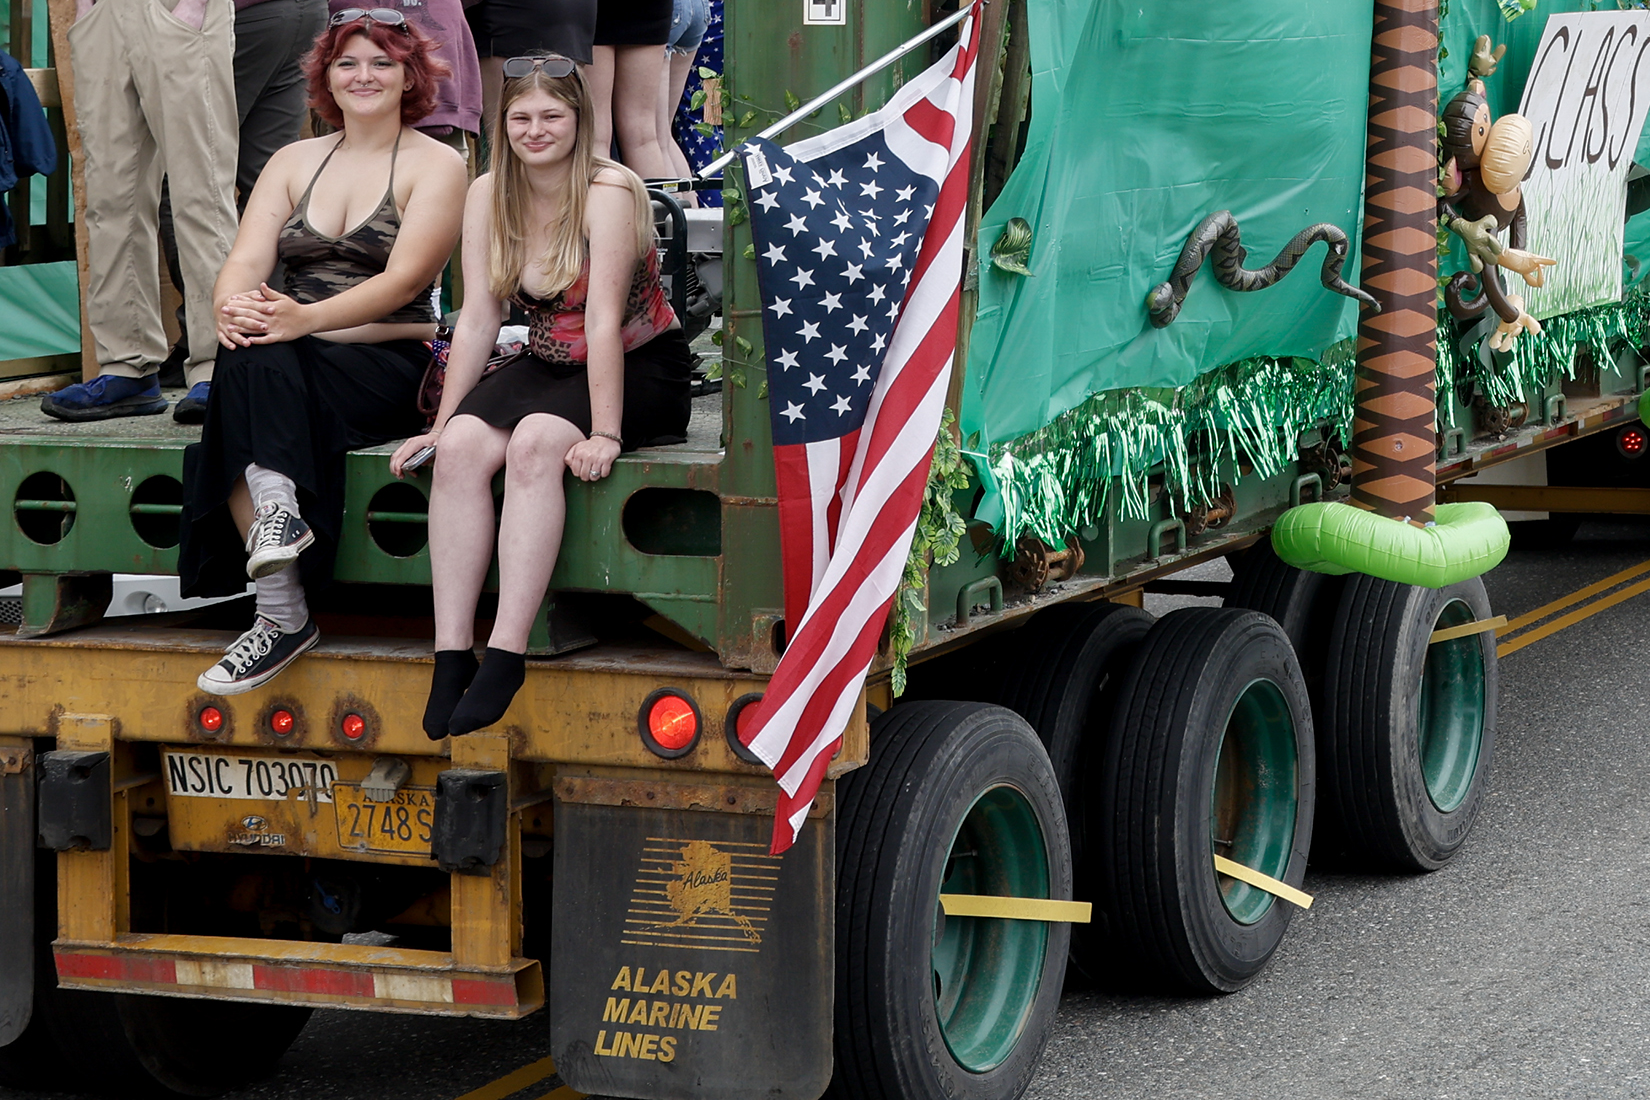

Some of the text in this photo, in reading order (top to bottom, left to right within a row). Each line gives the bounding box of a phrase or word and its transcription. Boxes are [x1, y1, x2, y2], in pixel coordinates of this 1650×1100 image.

[167, 755, 233, 794] NSIC
[227, 832, 285, 846] HYUNDAI
[347, 803, 432, 842] 2748S
[682, 868, 728, 890] Alaska
[610, 965, 738, 1000] ALASKA
[602, 996, 723, 1031] MARINE
[593, 1029, 679, 1063] LINES
